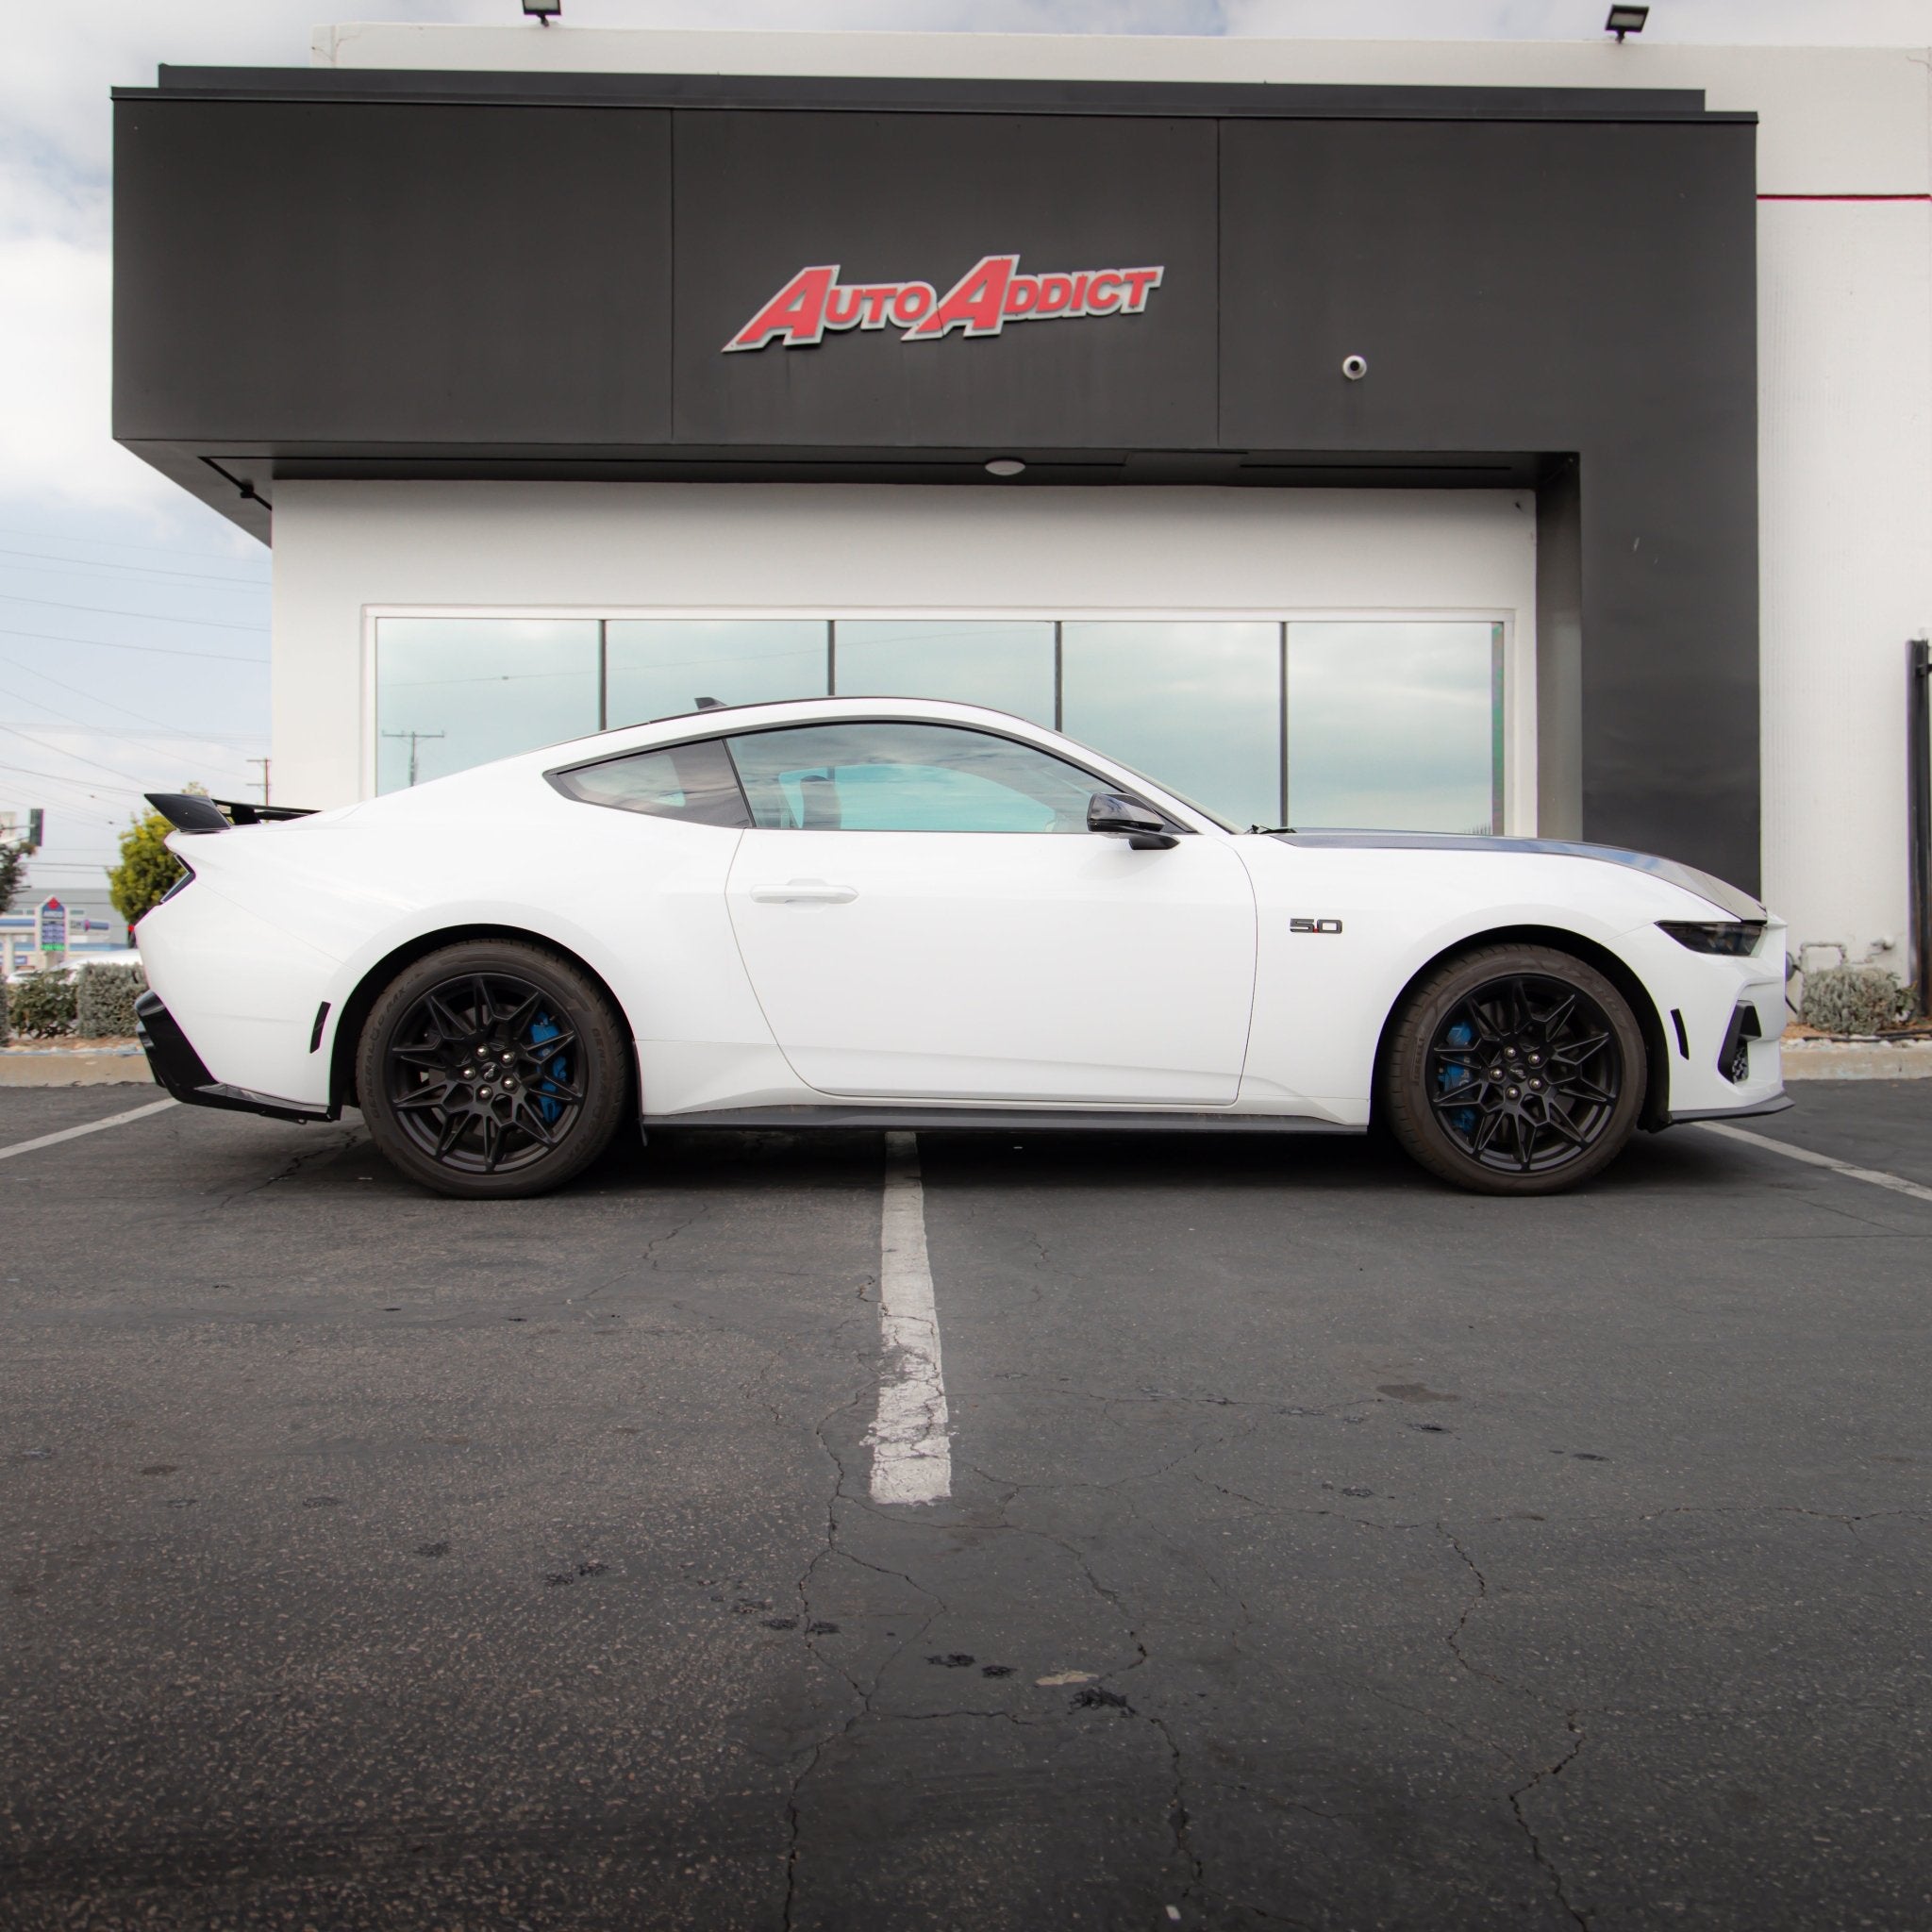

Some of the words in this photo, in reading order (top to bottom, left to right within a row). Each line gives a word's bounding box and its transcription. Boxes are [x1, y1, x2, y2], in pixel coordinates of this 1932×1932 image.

[723, 265, 936, 352] AUTO
[902, 255, 1164, 341] ADDICT
[1290, 918, 1342, 935] 5.0
